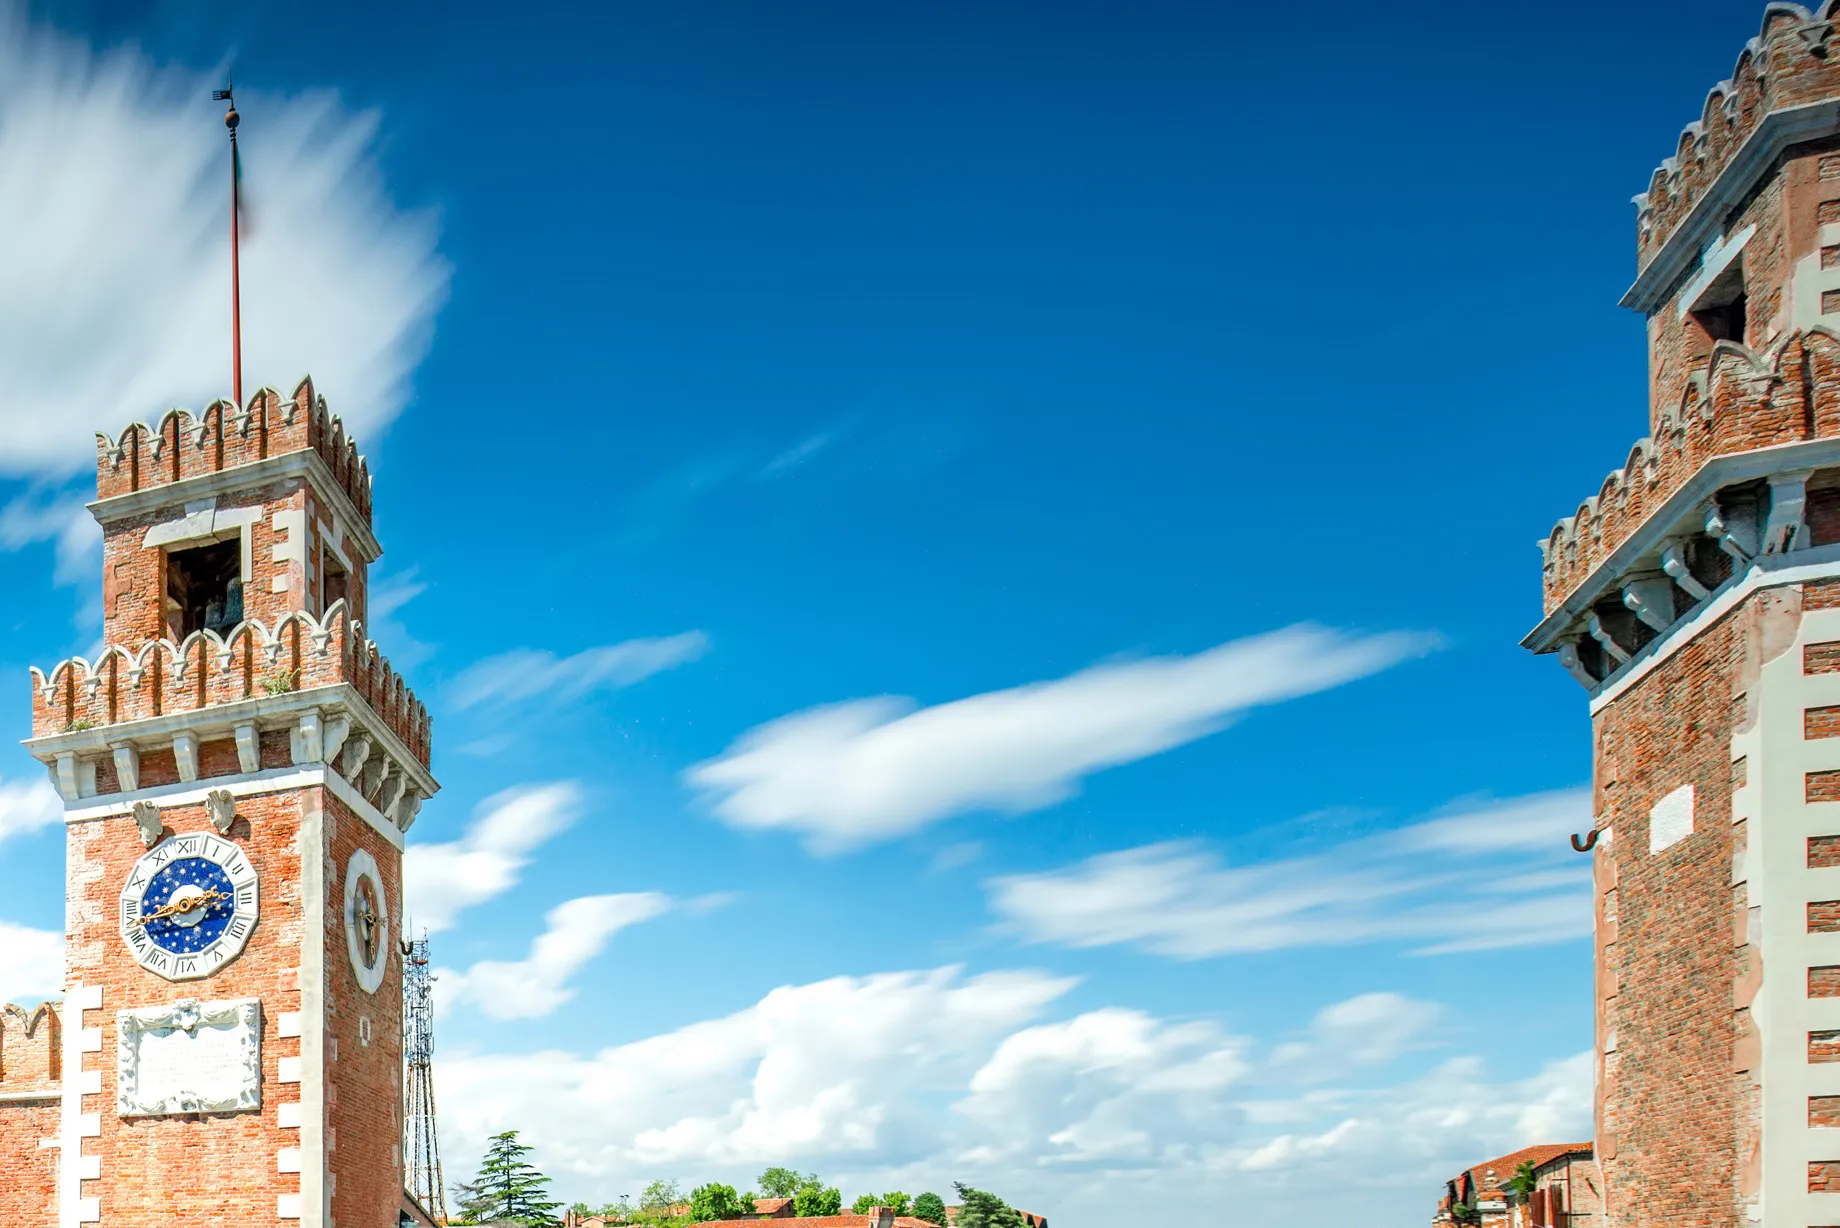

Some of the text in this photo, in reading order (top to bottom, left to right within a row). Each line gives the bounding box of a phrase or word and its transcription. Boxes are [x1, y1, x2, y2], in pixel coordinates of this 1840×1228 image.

[178, 840, 196, 854] XII
[212, 845, 220, 857] I
[152, 849, 169, 867] XI
[232, 863, 244, 875] II
[132, 875, 145, 890] X
[239, 892, 252, 904] III
[150, 953, 167, 970] VII
[213, 950, 224, 962] V
[181, 960, 196, 973] VI
